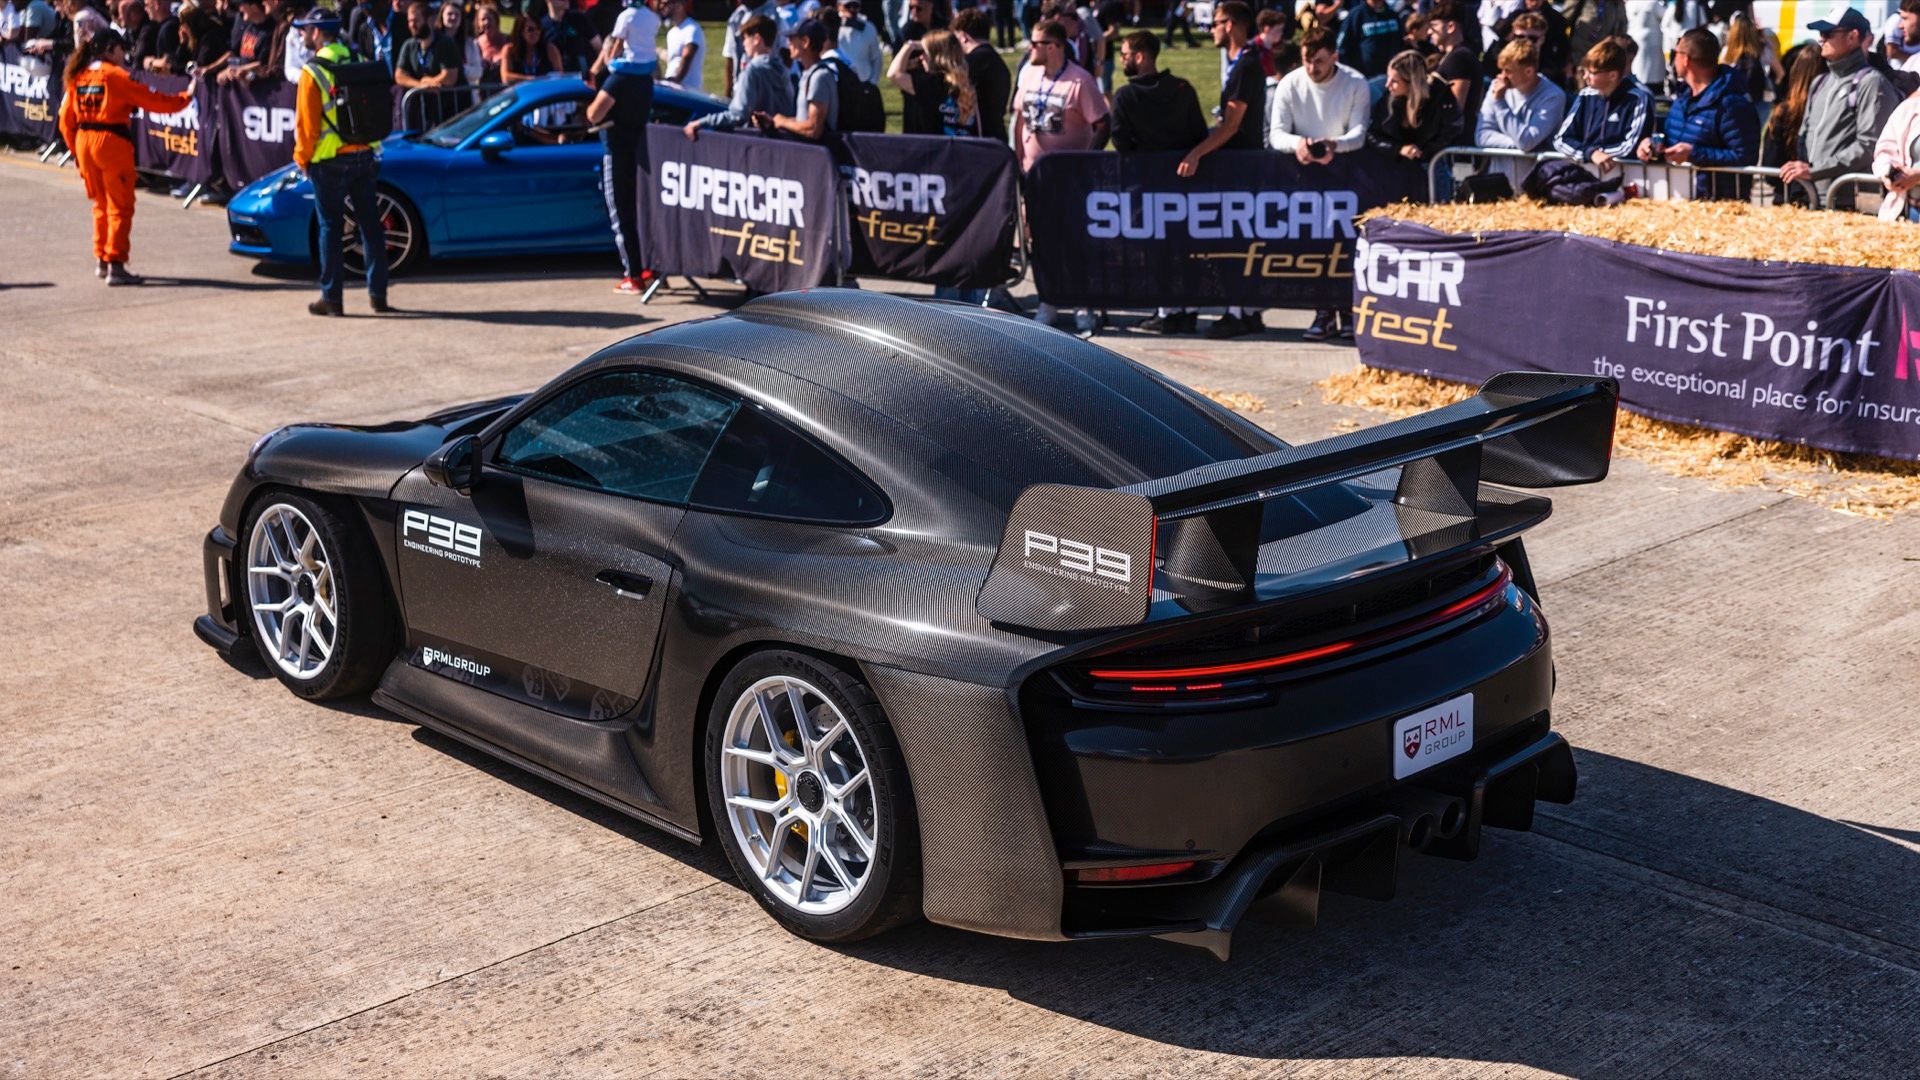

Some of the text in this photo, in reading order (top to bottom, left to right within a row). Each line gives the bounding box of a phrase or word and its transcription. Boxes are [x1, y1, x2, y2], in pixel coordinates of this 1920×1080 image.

[153, 126, 199, 156] fest
[660, 160, 805, 229] SUPERCAR
[1086, 190, 1359, 239] SUPERCAR
[715, 221, 805, 266] fest
[857, 209, 943, 246] fest
[1210, 242, 1355, 278] fest
[1352, 295, 1458, 351] fest
[1624, 295, 1880, 376] First Point
[1593, 356, 1626, 380] the
[1632, 366, 1746, 400] exceptional
[1752, 383, 1807, 412] place
[1816, 391, 1852, 415] for
[403, 509, 483, 557] P39
[403, 539, 481, 568] ENGINEERING PROTOTYPE
[1025, 529, 1131, 583] P39
[433, 650, 491, 677] RMLGROUP
[1425, 709, 1466, 740] RML
[1425, 730, 1466, 755] GROUP
